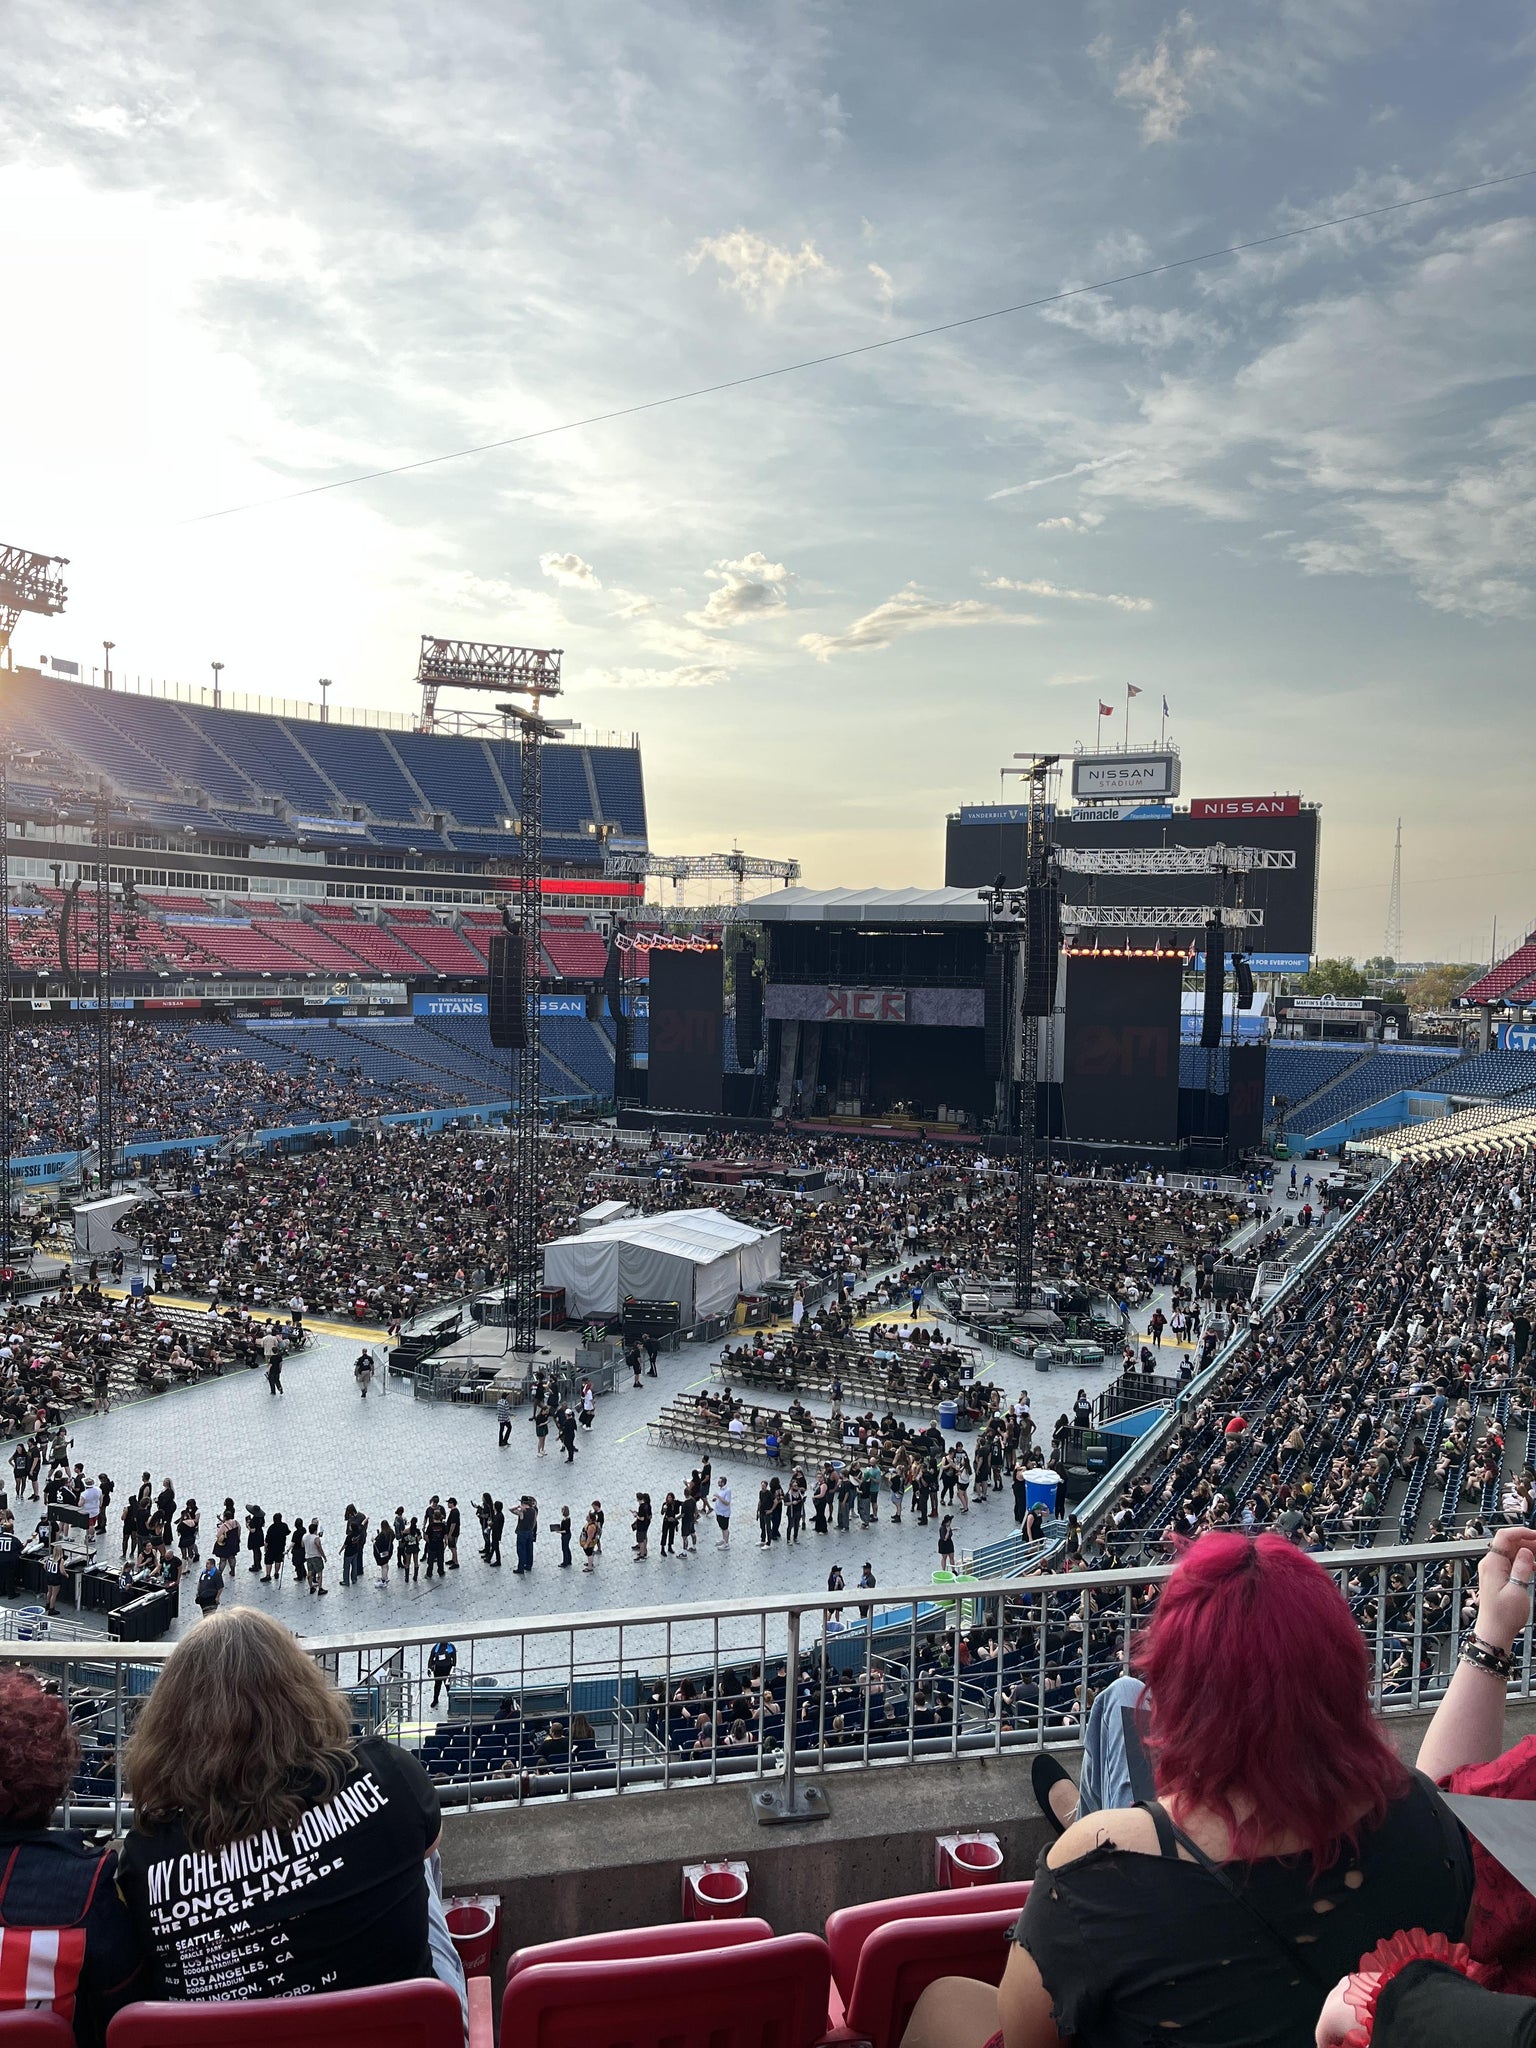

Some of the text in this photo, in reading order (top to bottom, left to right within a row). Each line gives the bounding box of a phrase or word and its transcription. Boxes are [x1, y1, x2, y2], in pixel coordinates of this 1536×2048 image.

[1089, 769, 1154, 779] NISSAN
[1072, 808, 1119, 820] Pinnacle
[1204, 802, 1284, 814] NISSAN
[428, 1002, 483, 1014] TITANS
[539, 1002, 581, 1010] SSAN
[10, 1164, 41, 1178] NNESSEE
[964, 1370, 970, 1378] E
[848, 1426, 855, 1436] K
[148, 1772, 389, 1905] MY CHEMICAL ROMANCE
[152, 1917, 182, 1936] THE
[189, 1896, 255, 1926] BLACK
[263, 1857, 344, 1902] PARADE
[176, 1929, 225, 1951] SEATTLE,
[230, 1920, 250, 1934] WA
[180, 1944, 222, 1960] ORACLE PARK
[182, 1960, 202, 1968] LOS
[205, 1943, 264, 1965] ANGELES,
[270, 1933, 290, 1946] CA
[184, 1952, 294, 1988] LOS ANGELES, CA
[210, 1958, 240, 1971] STADIUM
[214, 1976, 244, 1990] STADIUM
[267, 1972, 286, 1986] TX
[321, 1971, 337, 1986] NJ
